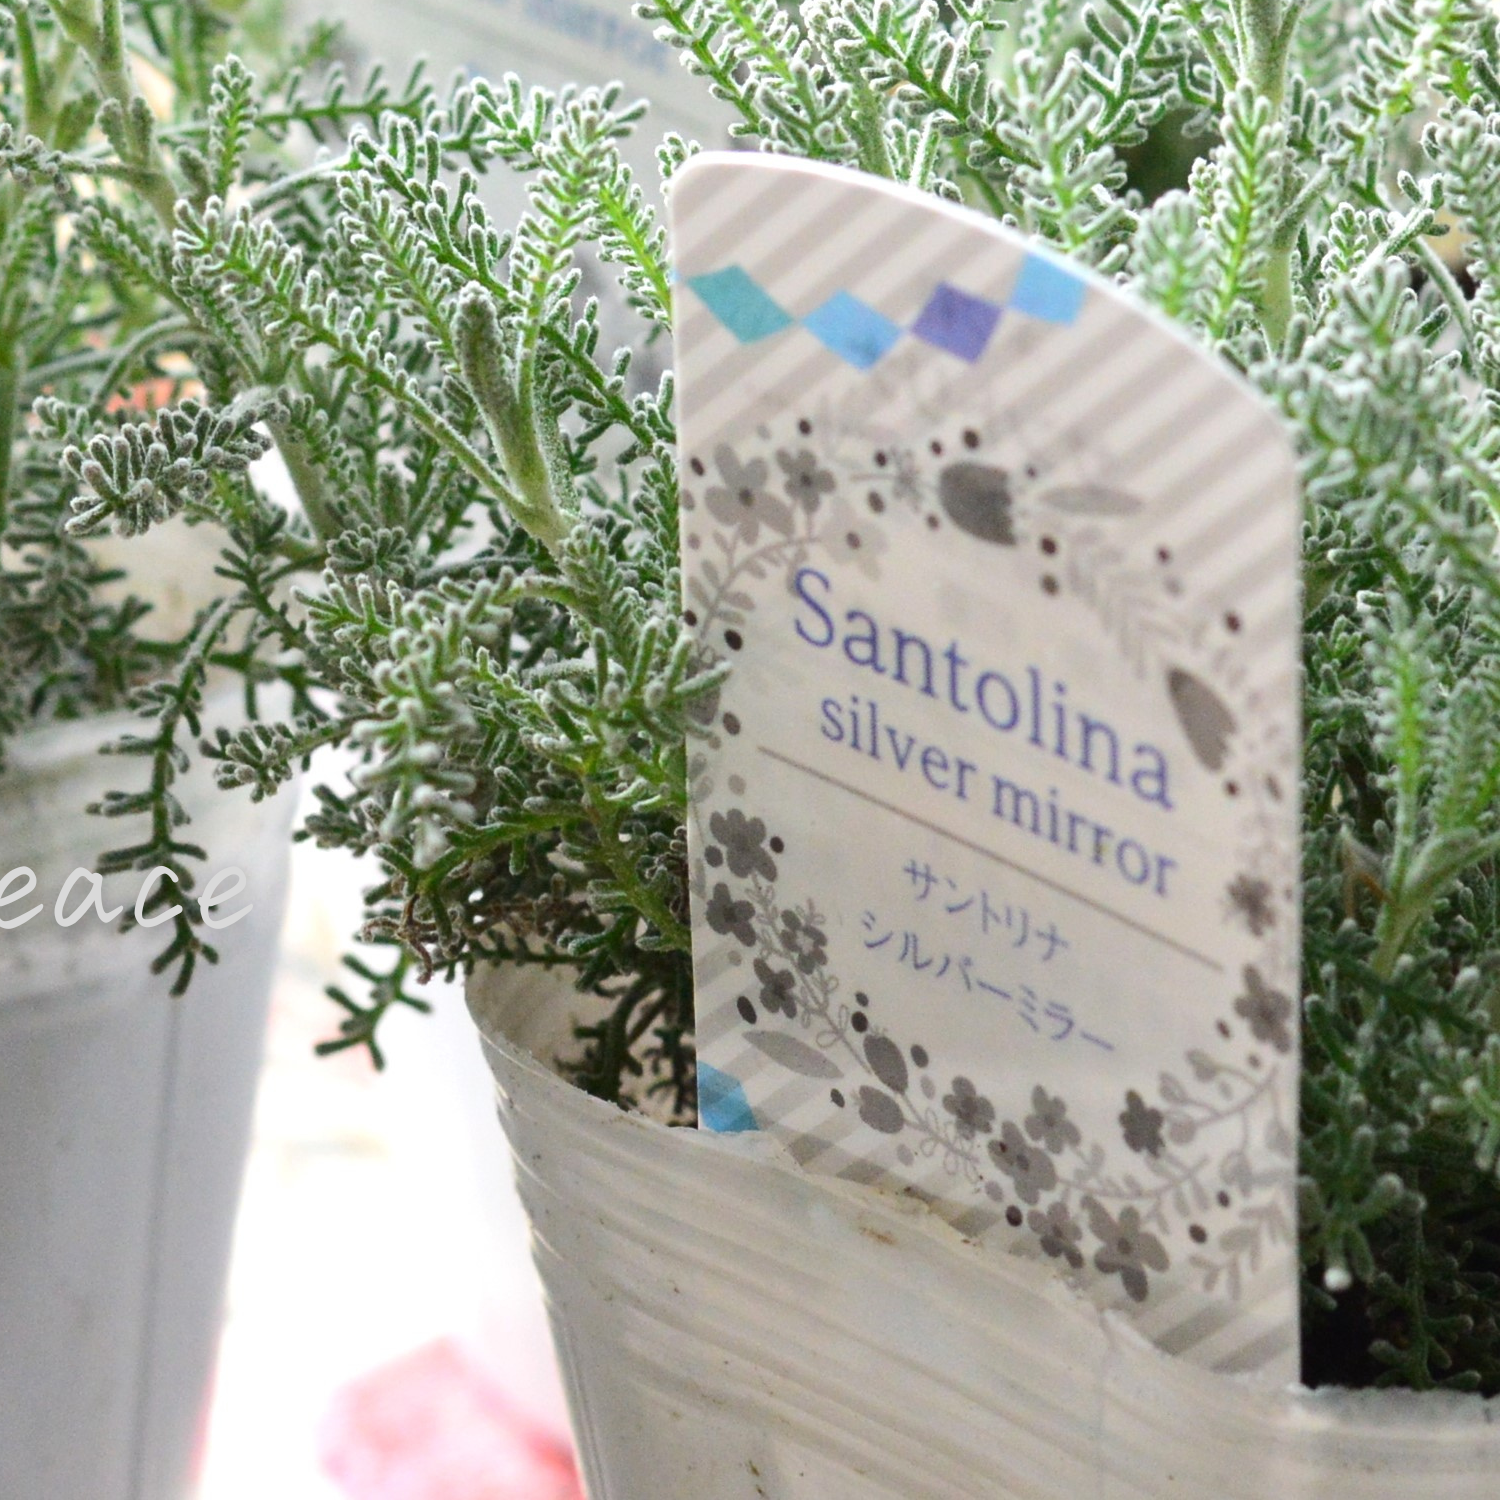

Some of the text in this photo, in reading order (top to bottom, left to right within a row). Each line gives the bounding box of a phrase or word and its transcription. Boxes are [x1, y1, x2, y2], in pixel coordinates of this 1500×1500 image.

[793, 567, 1175, 812] Santolina
[821, 696, 1177, 897] silver mirror
[903, 858, 1071, 962] サントリナ
